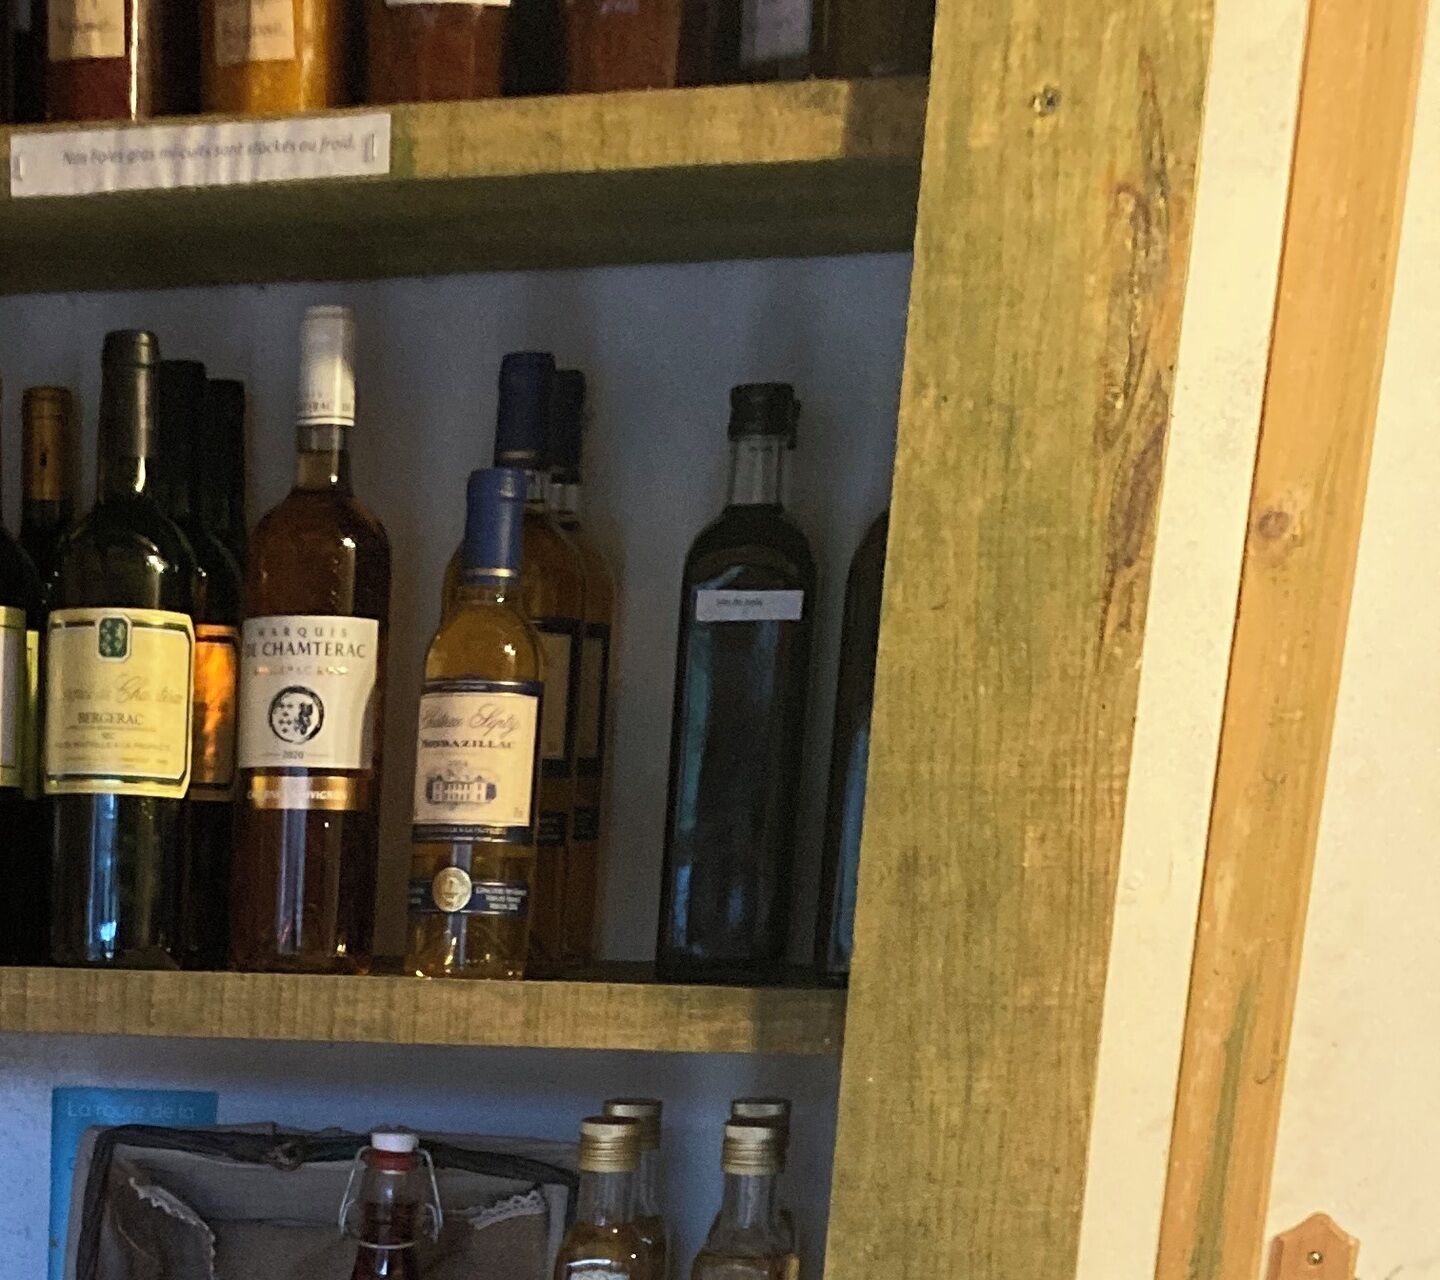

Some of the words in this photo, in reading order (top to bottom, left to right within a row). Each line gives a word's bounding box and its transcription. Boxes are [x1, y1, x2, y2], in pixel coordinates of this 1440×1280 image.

[257, 626, 349, 639] MARQUIS
[262, 640, 367, 659] CHAMTERAC
[77, 711, 145, 726] BERGERAC
